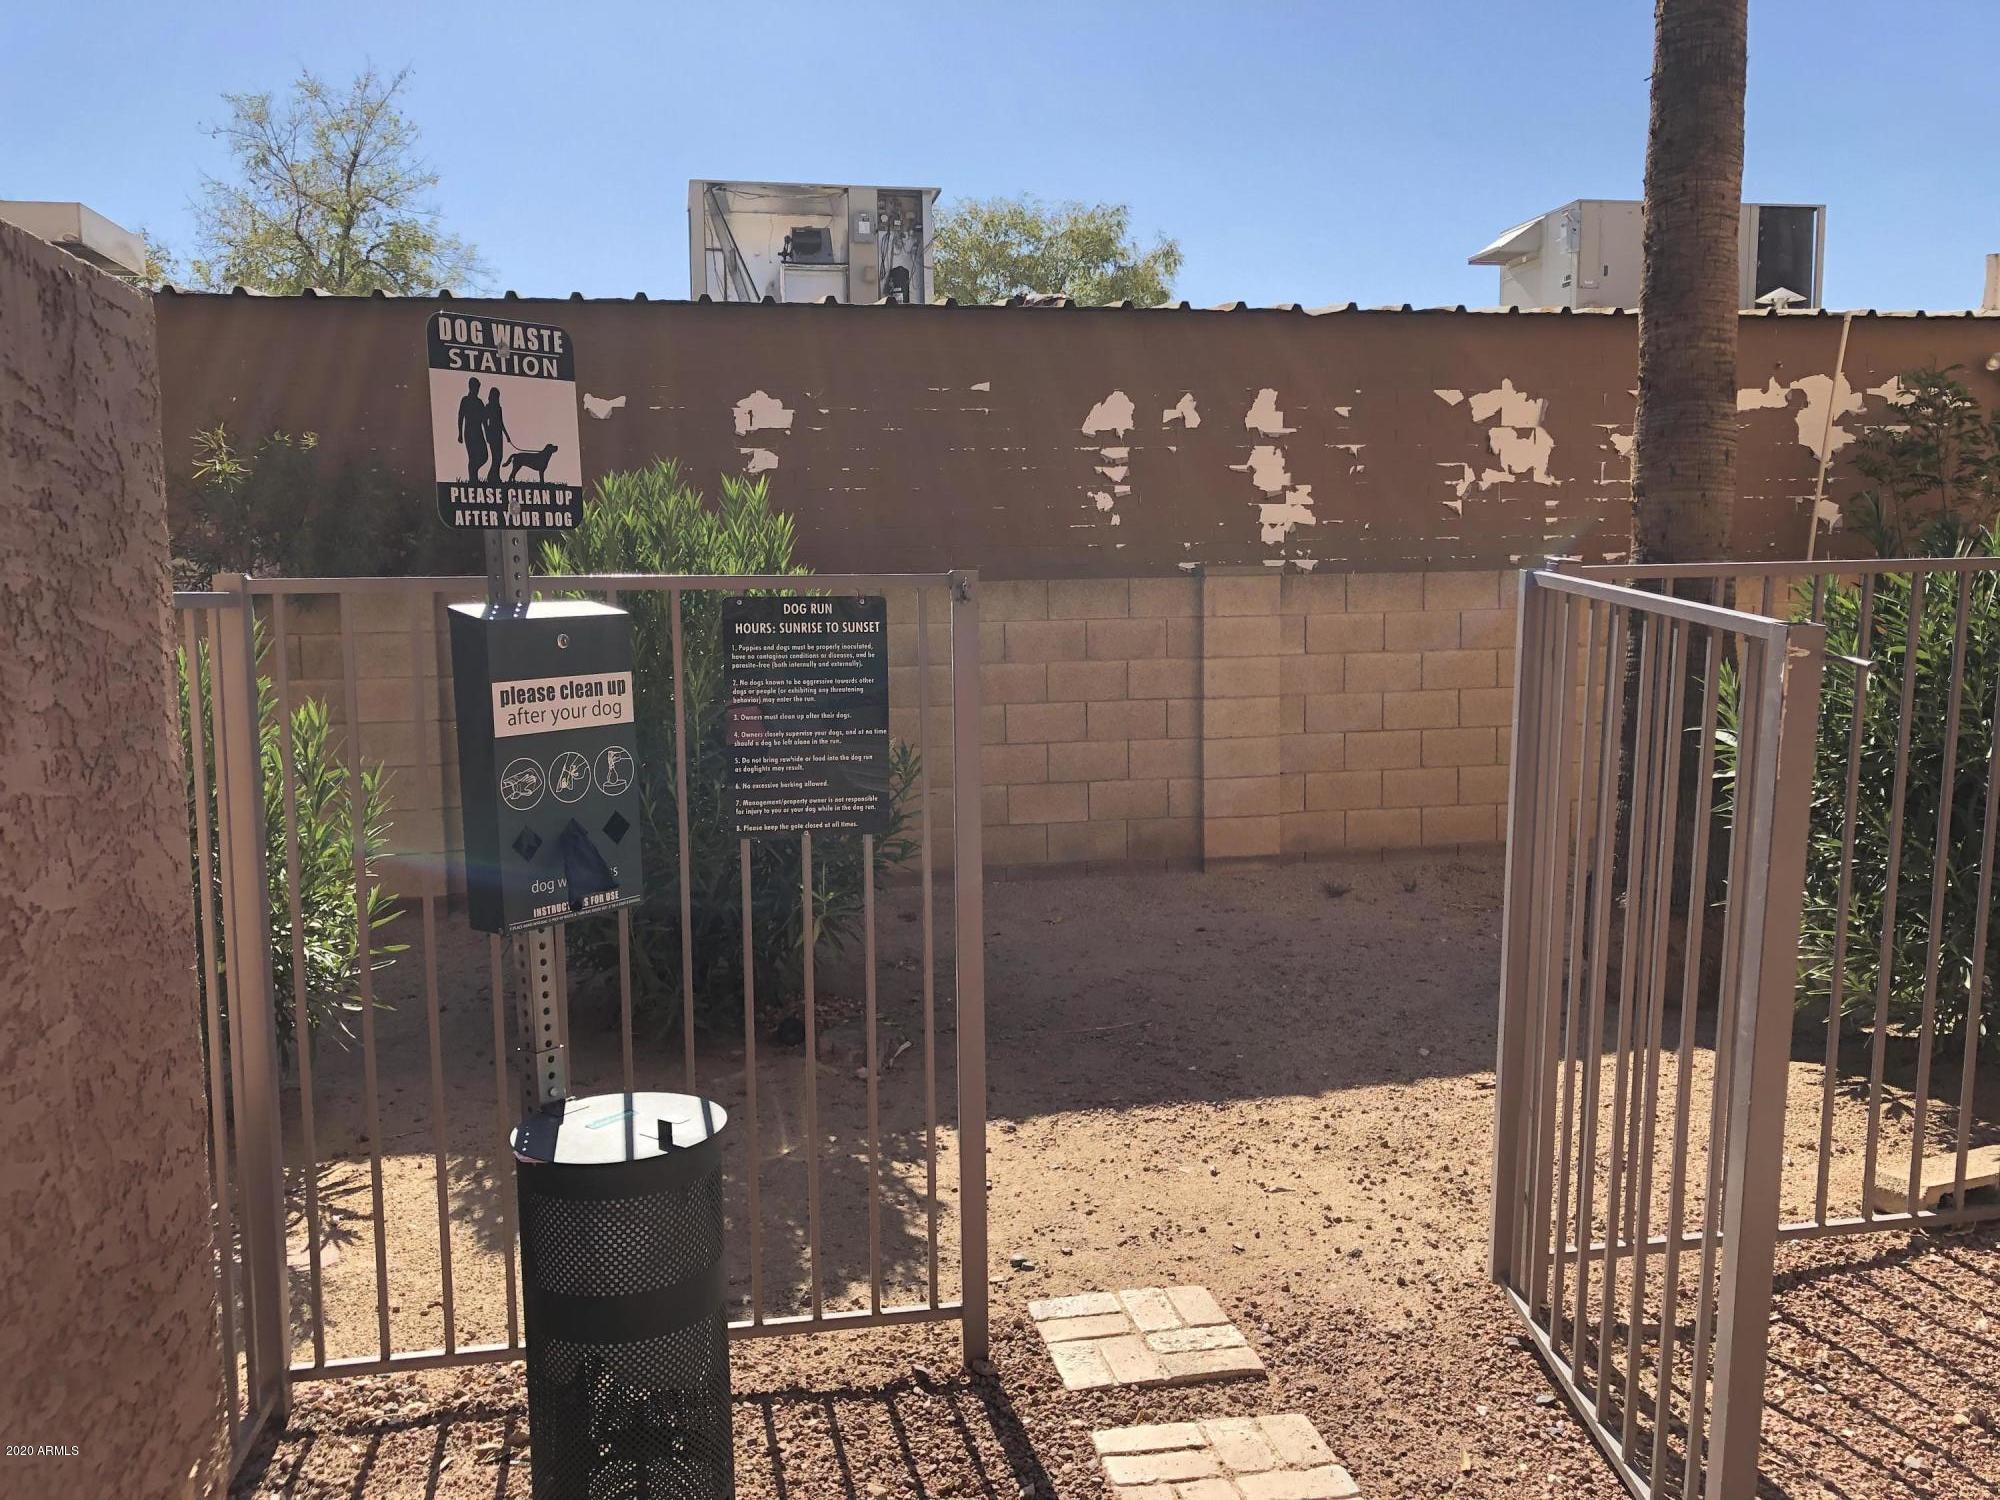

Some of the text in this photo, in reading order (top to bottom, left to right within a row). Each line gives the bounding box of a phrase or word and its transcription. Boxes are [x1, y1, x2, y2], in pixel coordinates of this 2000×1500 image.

[438, 316, 564, 354] DOG WASTE
[448, 348, 558, 378] STATION
[450, 487, 573, 506] PLEASE CLEAN UP
[455, 510, 572, 527] AFTER YOUR DOG
[784, 604, 832, 614] DOG RUN
[736, 622, 880, 634] HOURS: SUNRISE TO SUNSET
[750, 679, 764, 687] dogs
[500, 680, 626, 708] please clean up
[508, 700, 622, 726] after your dog
[786, 730, 812, 738] supervise
[763, 756, 778, 764] bring
[531, 880, 555, 894] dog
[534, 890, 619, 918] INSTRUCS FOR USE
